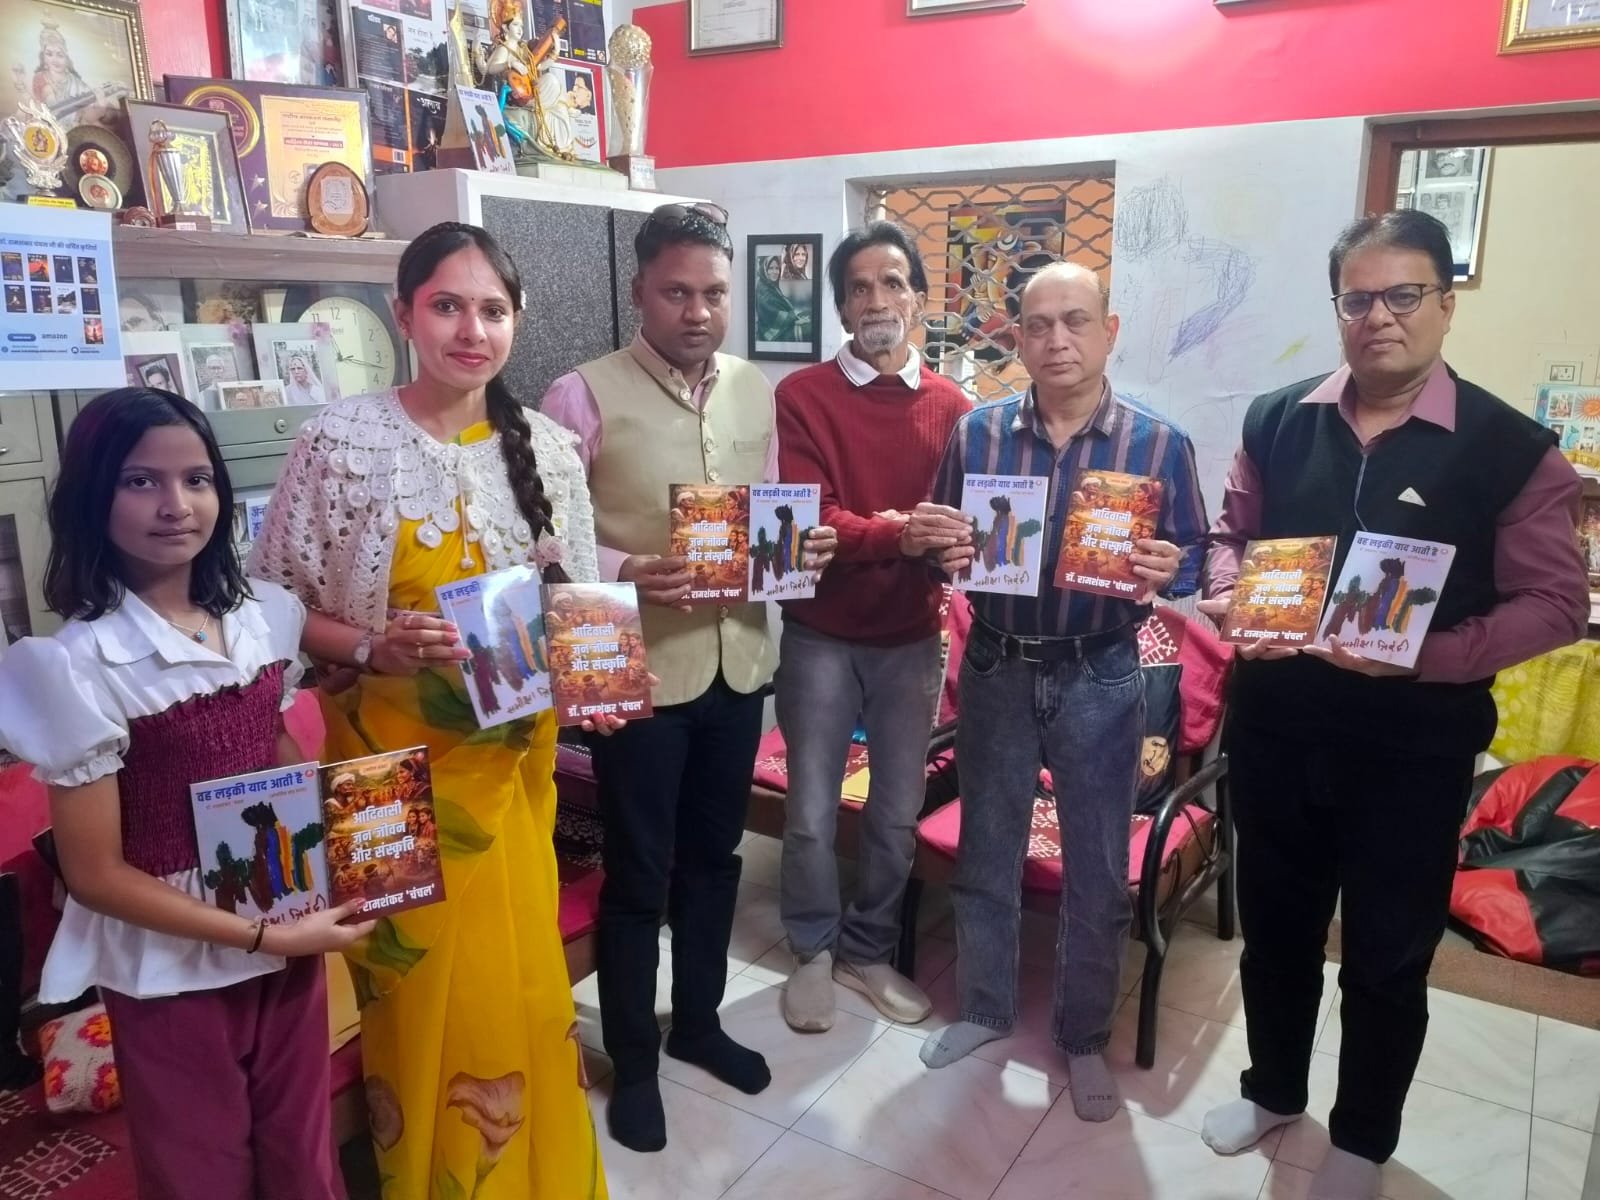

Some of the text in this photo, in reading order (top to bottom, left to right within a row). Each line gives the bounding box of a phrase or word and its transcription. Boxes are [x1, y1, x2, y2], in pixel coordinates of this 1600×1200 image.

[330, 307, 341, 320] 12
[368, 329, 374, 342] 2
[376, 350, 382, 364] 3
[373, 373, 379, 384] 4
[1091, 508, 1132, 522] आदिवासी
[454, 581, 480, 597] लड़की
[571, 622, 615, 637] आदिवासी
[591, 655, 627, 673] संस्कृति
[196, 771, 303, 801] वह लड़की याद आती है
[352, 800, 402, 824] आदिवासी
[351, 821, 406, 845] जन जीवन
[351, 835, 415, 864] और संस्कृति
[363, 893, 404, 912] रामशंकर
